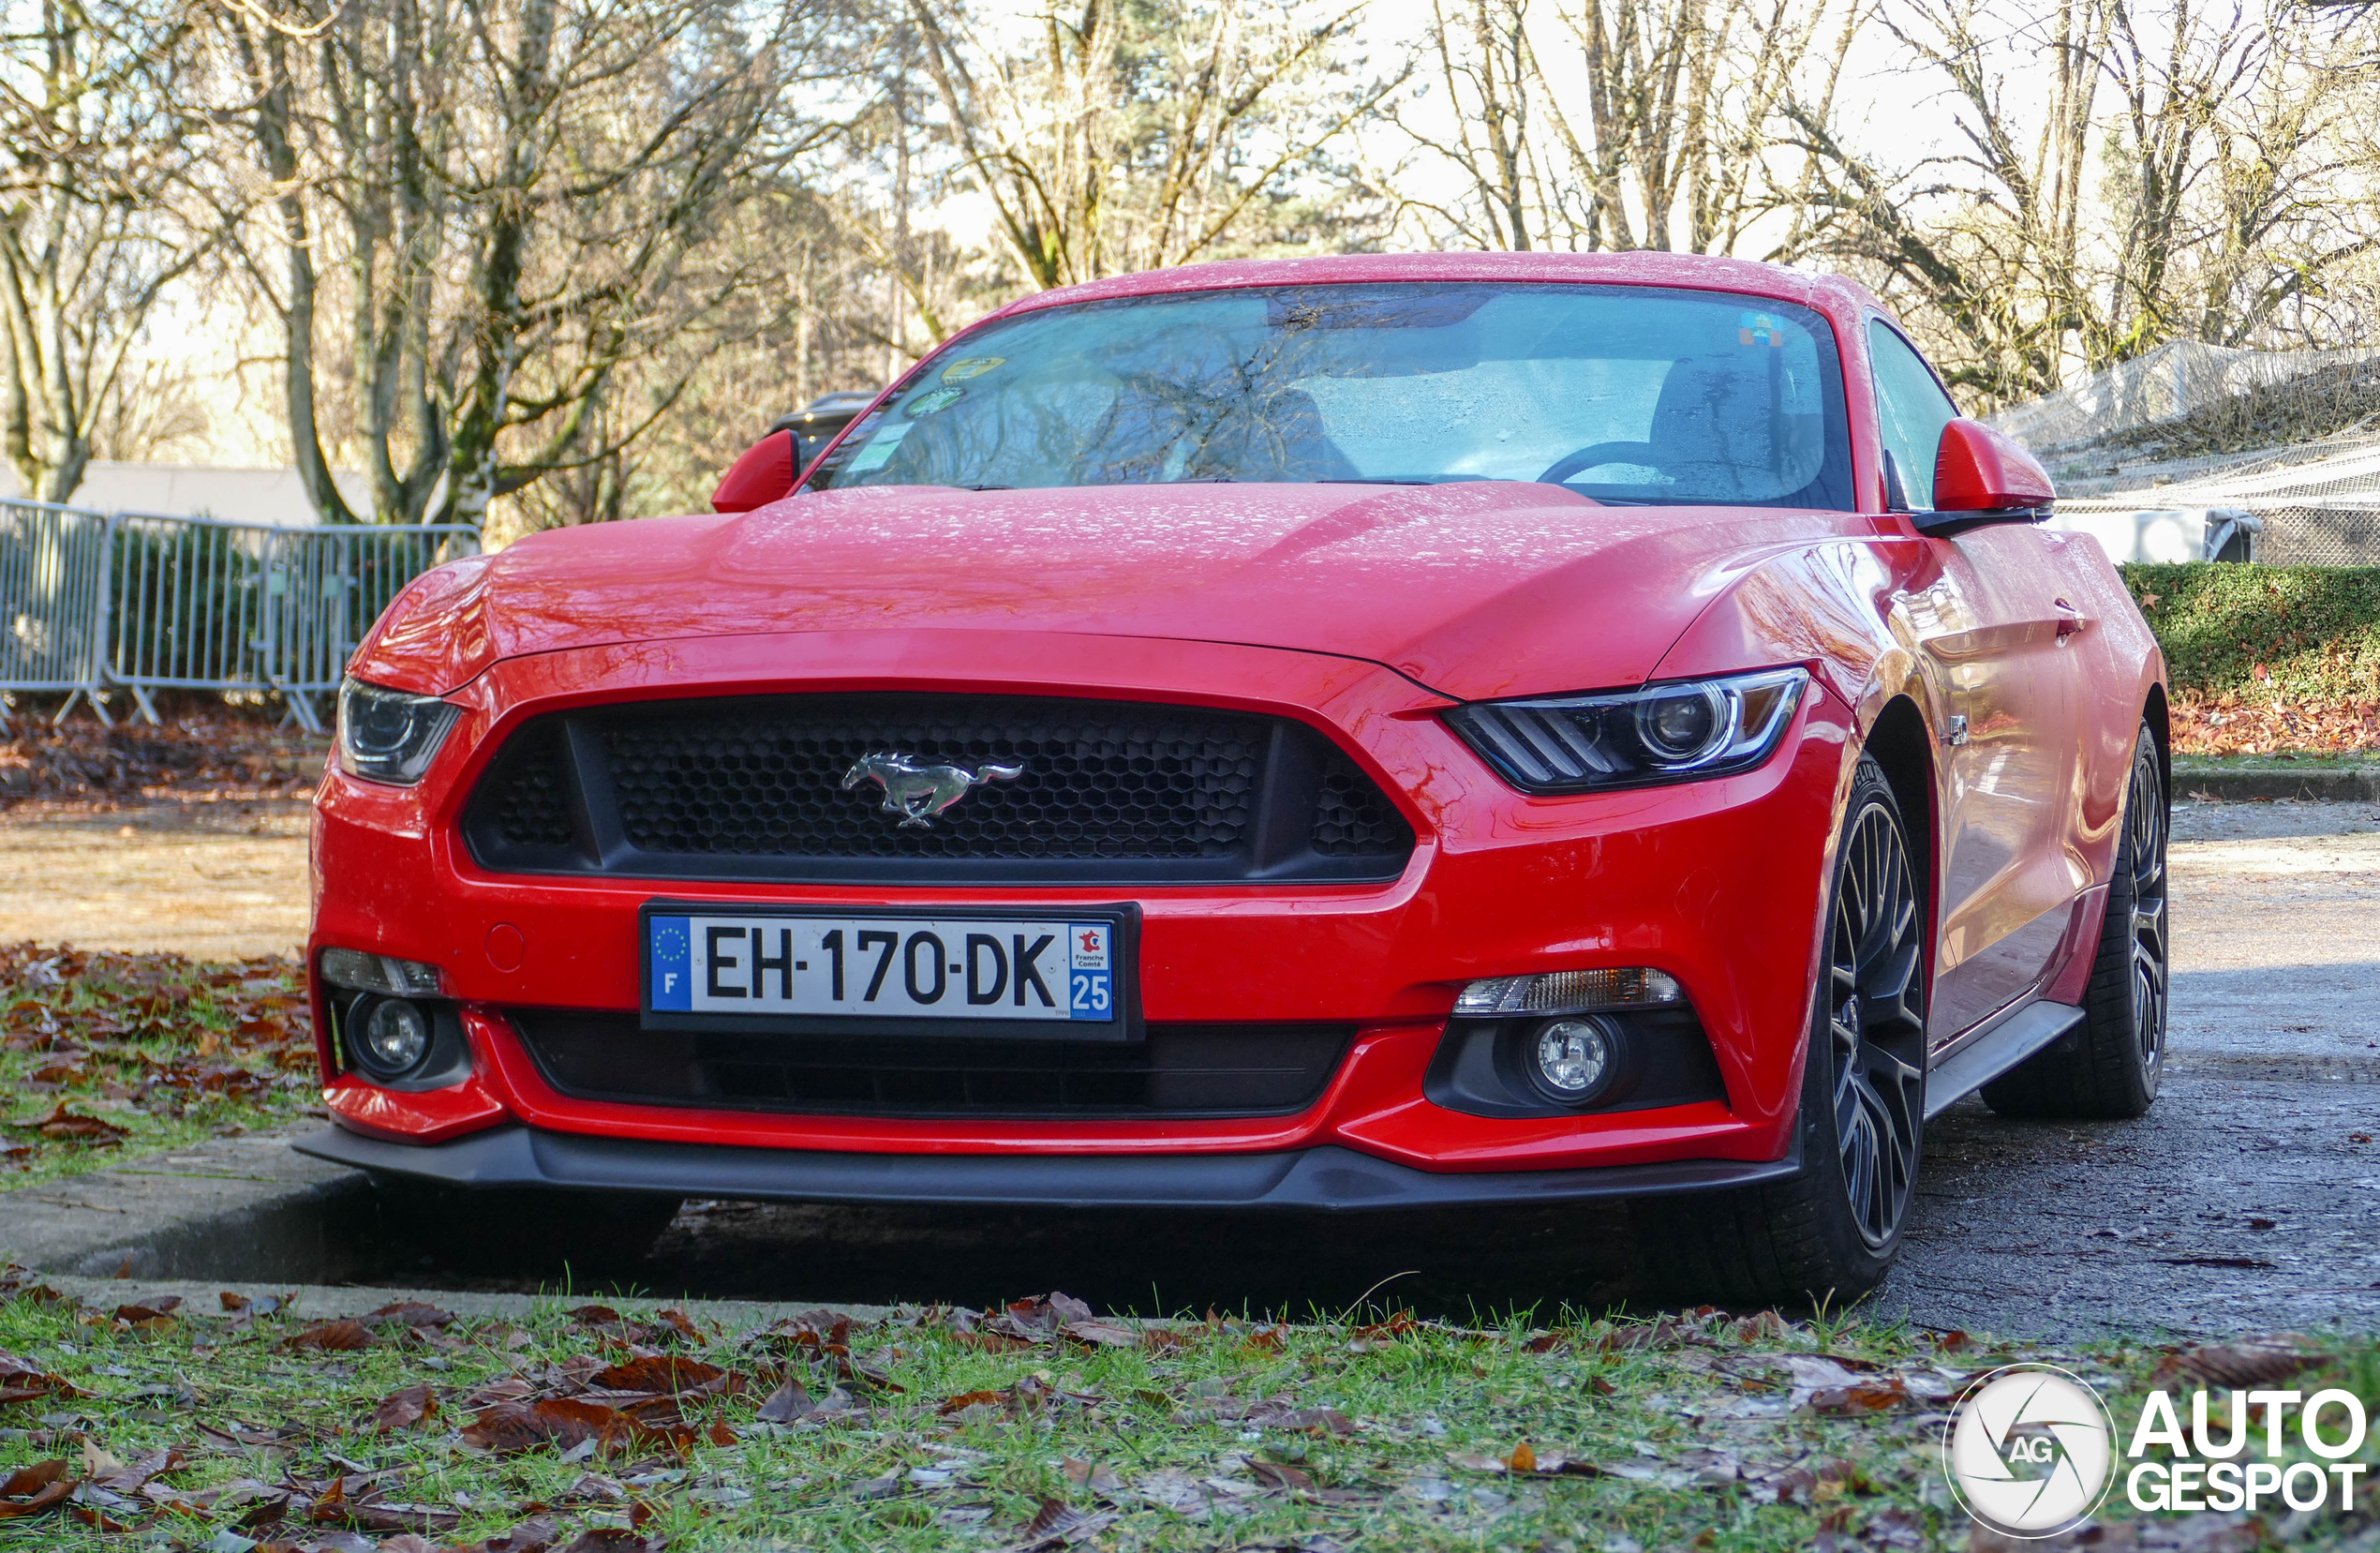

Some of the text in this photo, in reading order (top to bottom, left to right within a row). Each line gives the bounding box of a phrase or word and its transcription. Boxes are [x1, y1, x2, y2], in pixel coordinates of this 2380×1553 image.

[664, 973, 677, 994] F
[706, 926, 1057, 1008] EH-170-DK
[1072, 975, 1109, 1010] 25
